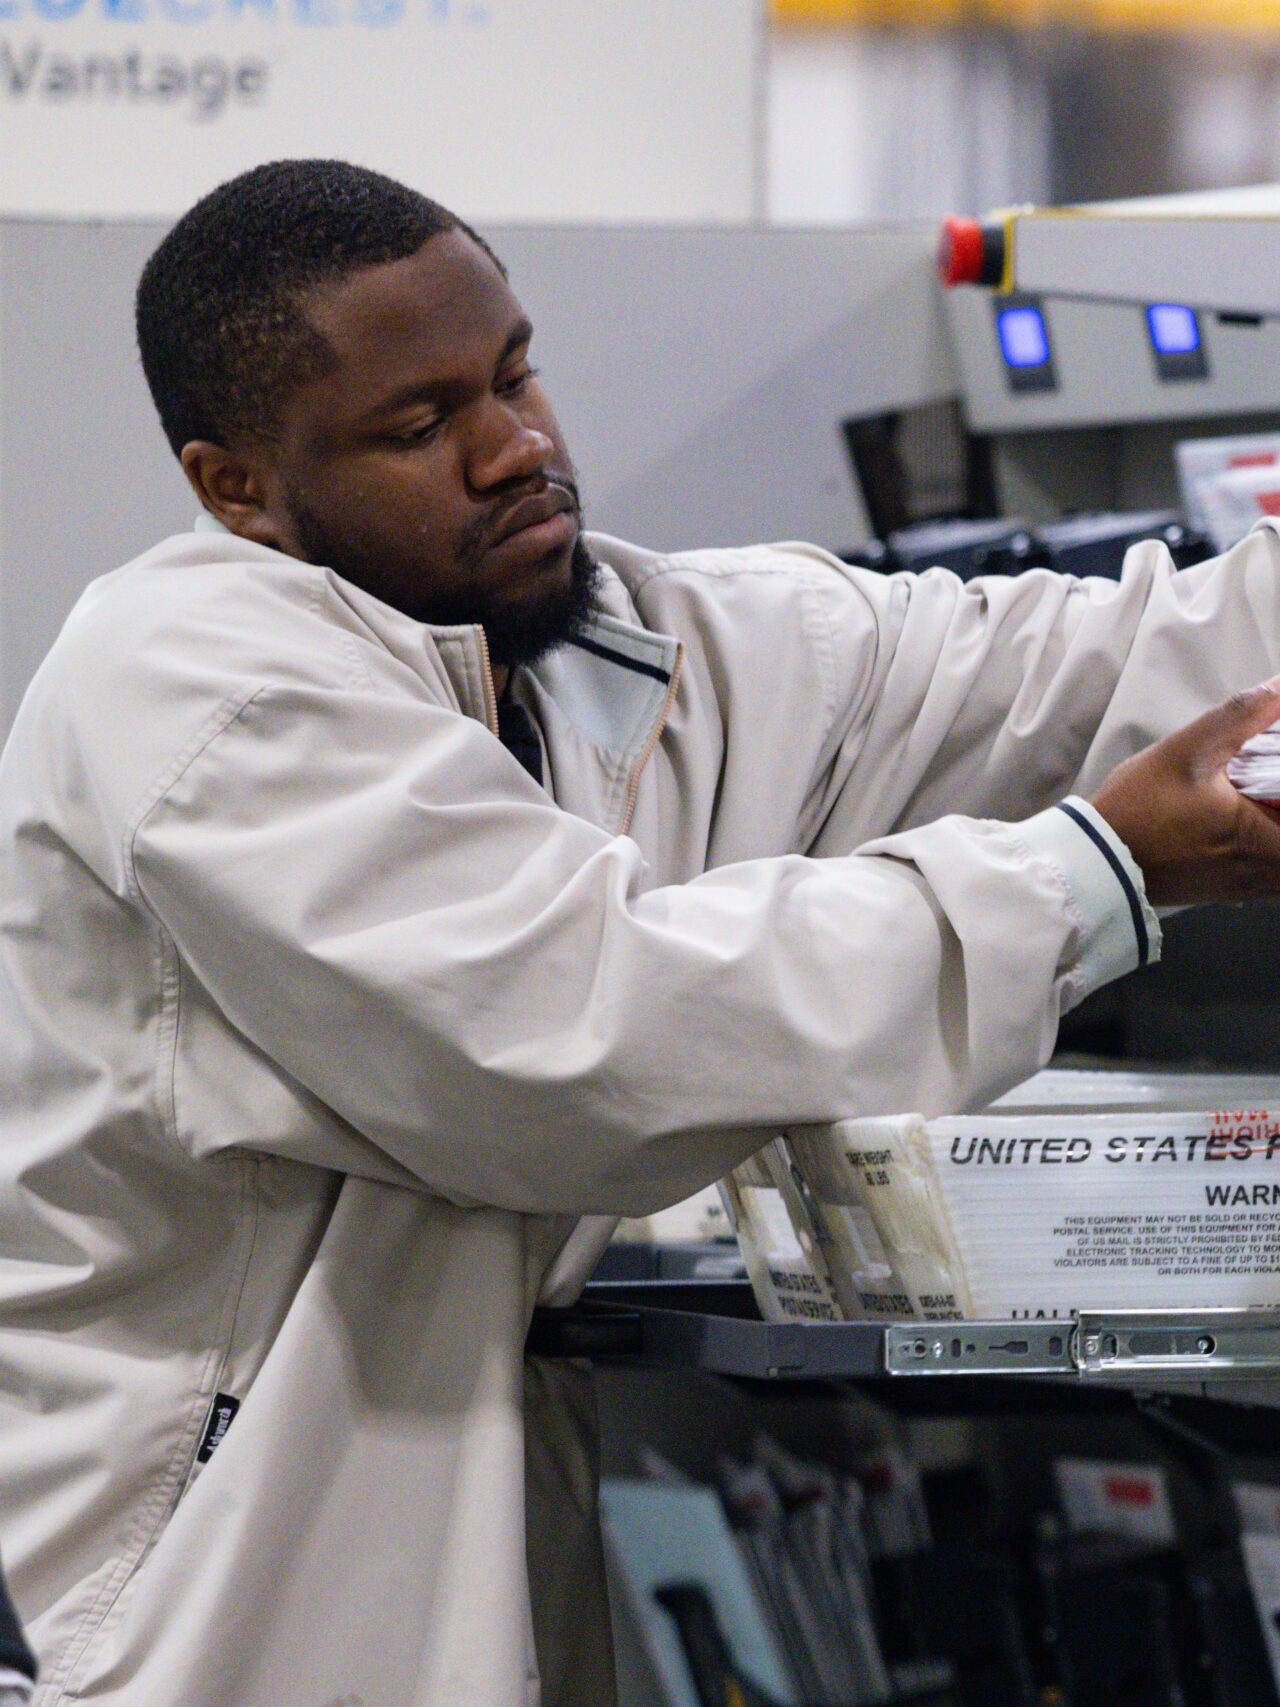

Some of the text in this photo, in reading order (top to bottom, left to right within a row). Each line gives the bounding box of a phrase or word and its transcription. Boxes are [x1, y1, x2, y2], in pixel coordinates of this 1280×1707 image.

[0, 40, 267, 124] Vantage
[950, 1137, 1093, 1165] UNITED
[1104, 1134, 1253, 1163] STATES
[1064, 1216, 1085, 1225] THIS
[1088, 1215, 1142, 1225] EQUIPMENT
[1145, 1215, 1165, 1224] MAY
[1167, 1215, 1187, 1223] NOT
[1189, 1214, 1201, 1223] BE
[1205, 1214, 1230, 1222] SOLD
[1233, 1213, 1246, 1222] OR
[1053, 1227, 1090, 1236] POSTAL
[1138, 1226, 1157, 1235] USE
[1160, 1226, 1172, 1234] OF
[1176, 1225, 1196, 1234] THIS
[1199, 1224, 1254, 1233] EQUIPMENT
[1256, 1223, 1275, 1232] FOR
[1077, 1237, 1090, 1246] OF
[1093, 1237, 1105, 1246] US
[1108, 1237, 1131, 1245] MAIL
[1133, 1237, 1142, 1245] IS
[1145, 1236, 1189, 1245] STRICTLY
[1191, 1235, 1248, 1244] PROHIBITED
[1251, 1234, 1264, 1243] BY
[1066, 1248, 1127, 1257] ELECTRONIC
[1130, 1247, 1178, 1256] TRACKING
[1181, 1245, 1246, 1255] TECHNOLOGY
[1250, 1245, 1261, 1253] TO
[1054, 1258, 1107, 1267] VIOLATORS
[1109, 1258, 1129, 1267] ARE
[1132, 1257, 1174, 1266] SUBJECT
[1177, 1256, 1190, 1265] TO
[1192, 1256, 1199, 1264] A
[1201, 1255, 1221, 1264] FINE
[1224, 1255, 1236, 1263] OF
[1240, 1254, 1252, 1263] UP
[1255, 1254, 1268, 1263] TO
[1157, 1267, 1171, 1275] OR
[1174, 1266, 1200, 1275] BOTH
[1203, 1266, 1221, 1274] FOR
[1224, 1265, 1250, 1274] EACH
